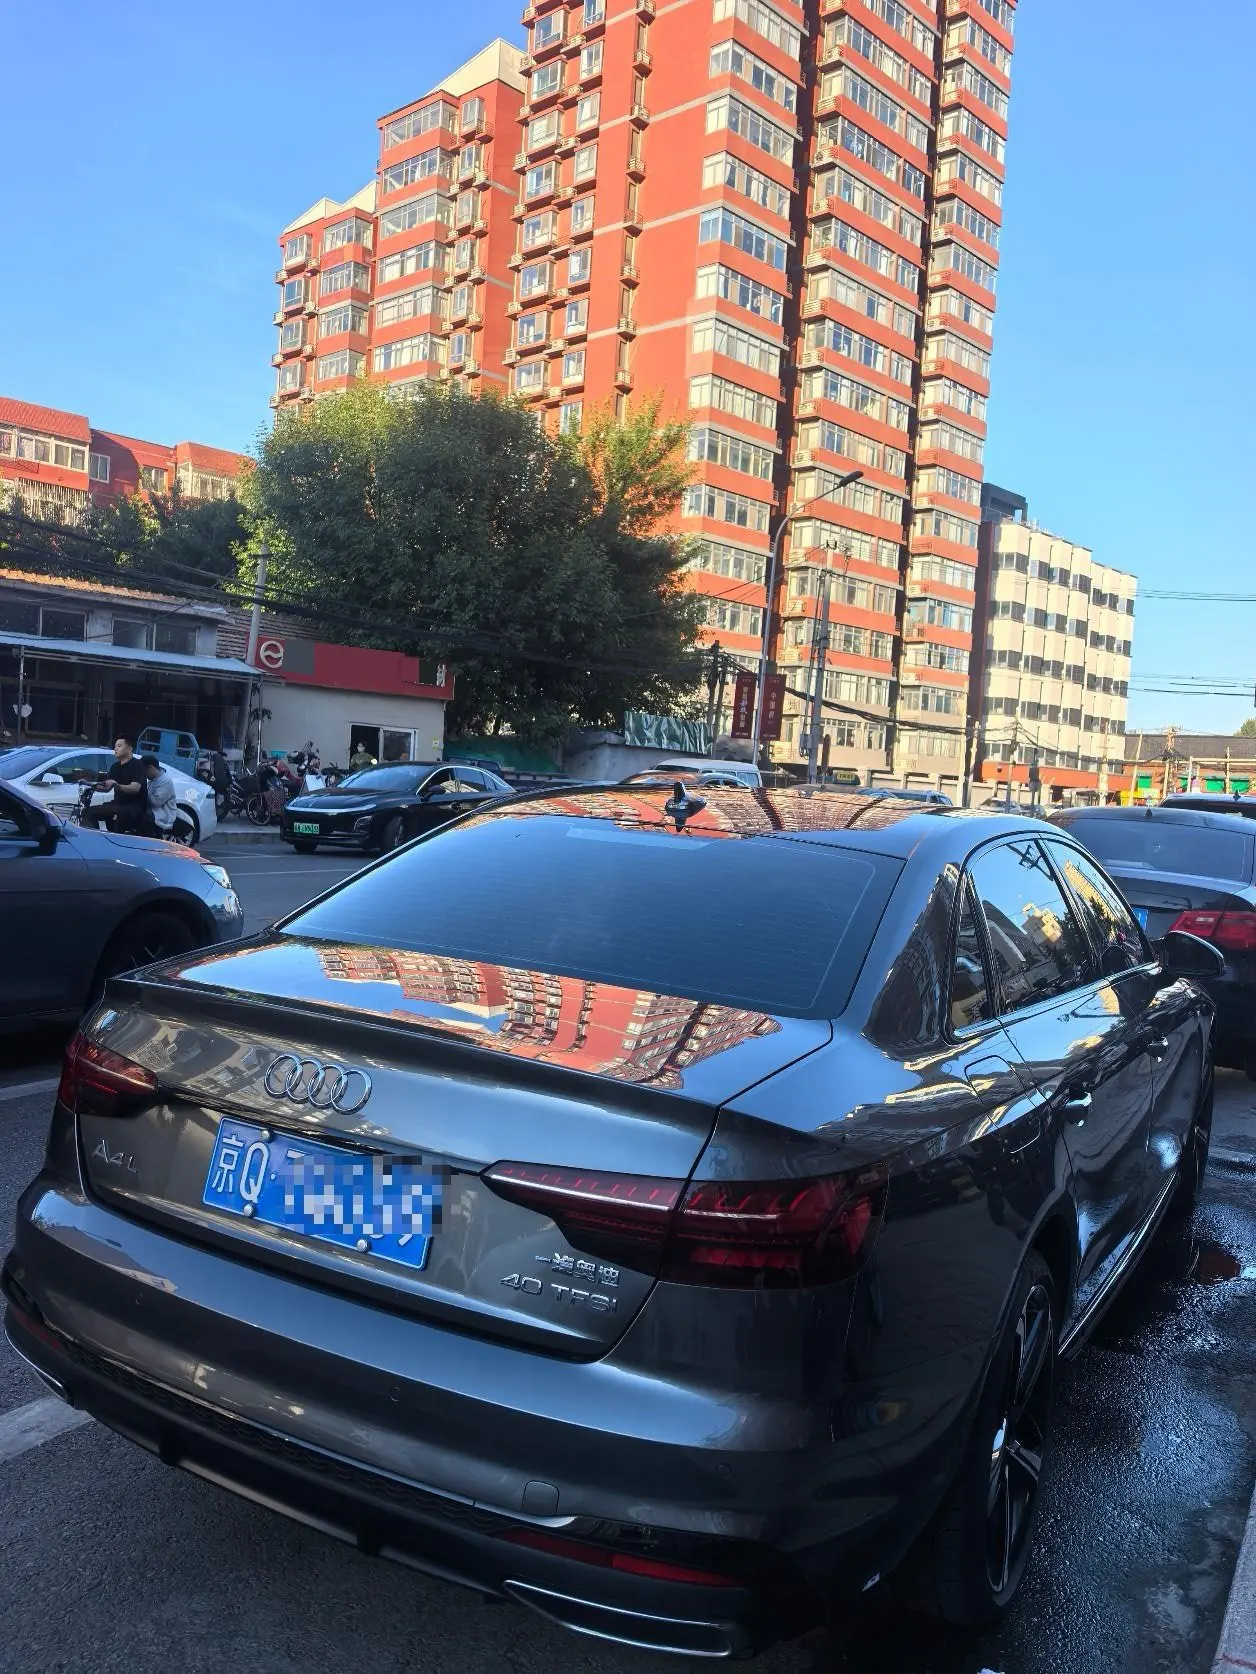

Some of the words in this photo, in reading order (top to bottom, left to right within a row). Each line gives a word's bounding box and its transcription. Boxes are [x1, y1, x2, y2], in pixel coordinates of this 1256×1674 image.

[91, 1138, 137, 1173] A4L
[535, 1253, 620, 1287] 一汽奥迪
[499, 1272, 543, 1296] 40
[550, 1283, 618, 1313] TFSI
